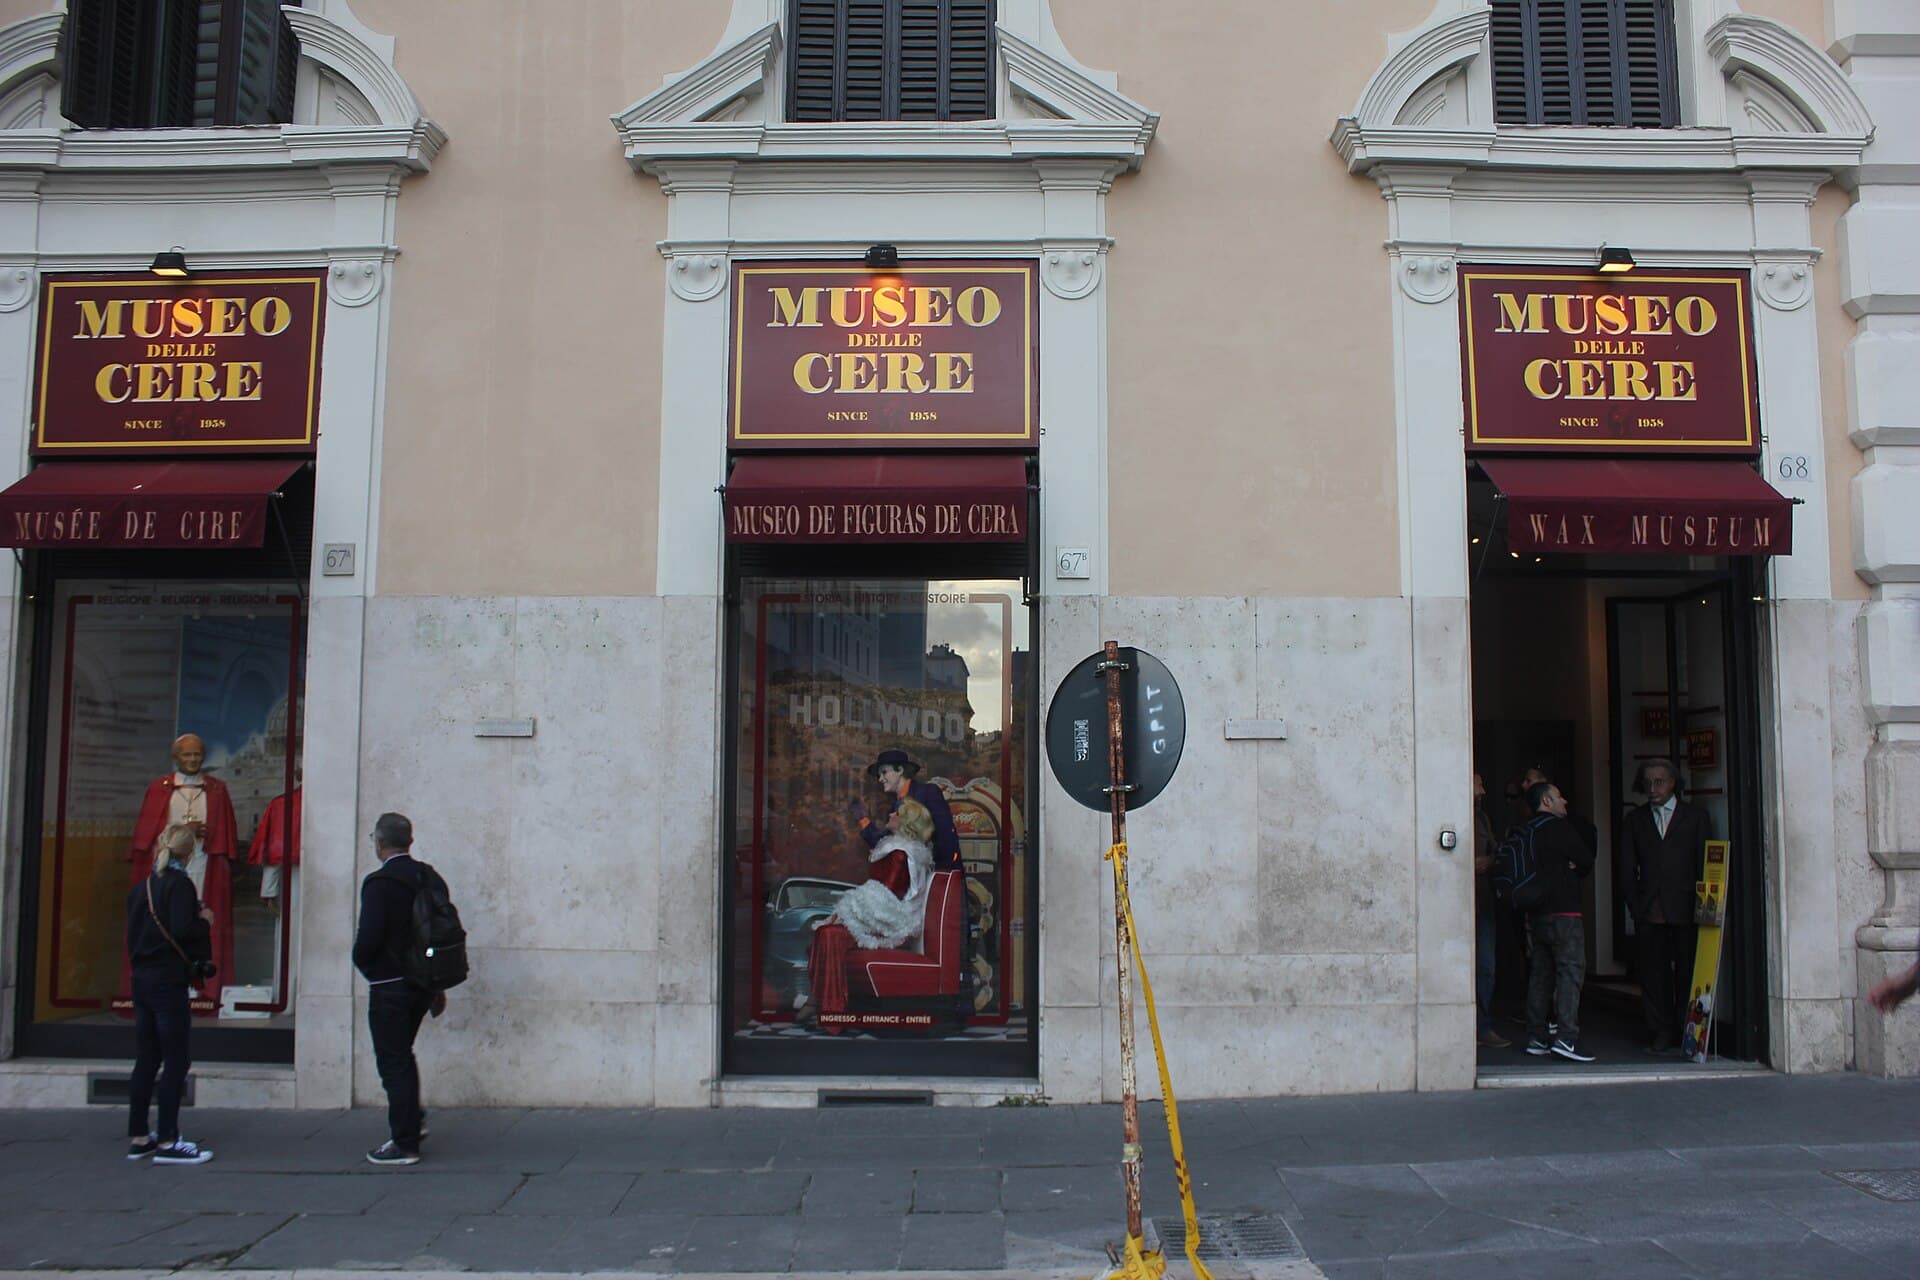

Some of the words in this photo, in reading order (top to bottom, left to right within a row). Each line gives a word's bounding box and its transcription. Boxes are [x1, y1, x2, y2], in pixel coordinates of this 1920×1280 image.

[72, 297, 292, 340] MUSEO
[766, 286, 1002, 328] MUSEO
[1493, 293, 1718, 337] MUSEO
[145, 343, 216, 358] DELLE
[847, 333, 923, 348] DELLE
[1573, 340, 1645, 355] DELLE
[95, 362, 263, 404] CERE
[793, 352, 974, 395] CERE
[1524, 358, 1697, 401] CERE
[124, 419, 163, 430] SINCE
[199, 418, 226, 429] 1958
[827, 411, 868, 421] SINCE
[909, 411, 937, 421] 1958
[1559, 417, 1599, 427] SINCE
[1636, 417, 1664, 428] 1958
[1778, 456, 1809, 479] 68
[16, 508, 101, 541] MUSÉE
[124, 510, 157, 540] DE
[180, 510, 243, 541] CIRE
[733, 505, 800, 536] MUSEO
[808, 504, 836, 535] DE
[842, 504, 926, 535] FIGURAS
[934, 504, 960, 534] DE
[967, 504, 1020, 534] CERA
[1529, 513, 1595, 546] WAX
[1631, 515, 1771, 547] MUSEUM
[789, 694, 996, 743] HOLLYWOO
[820, 1014, 857, 1023] INGRESSO
[862, 1014, 900, 1024] ENTRANCE
[905, 1014, 932, 1024] ENTRÉE
